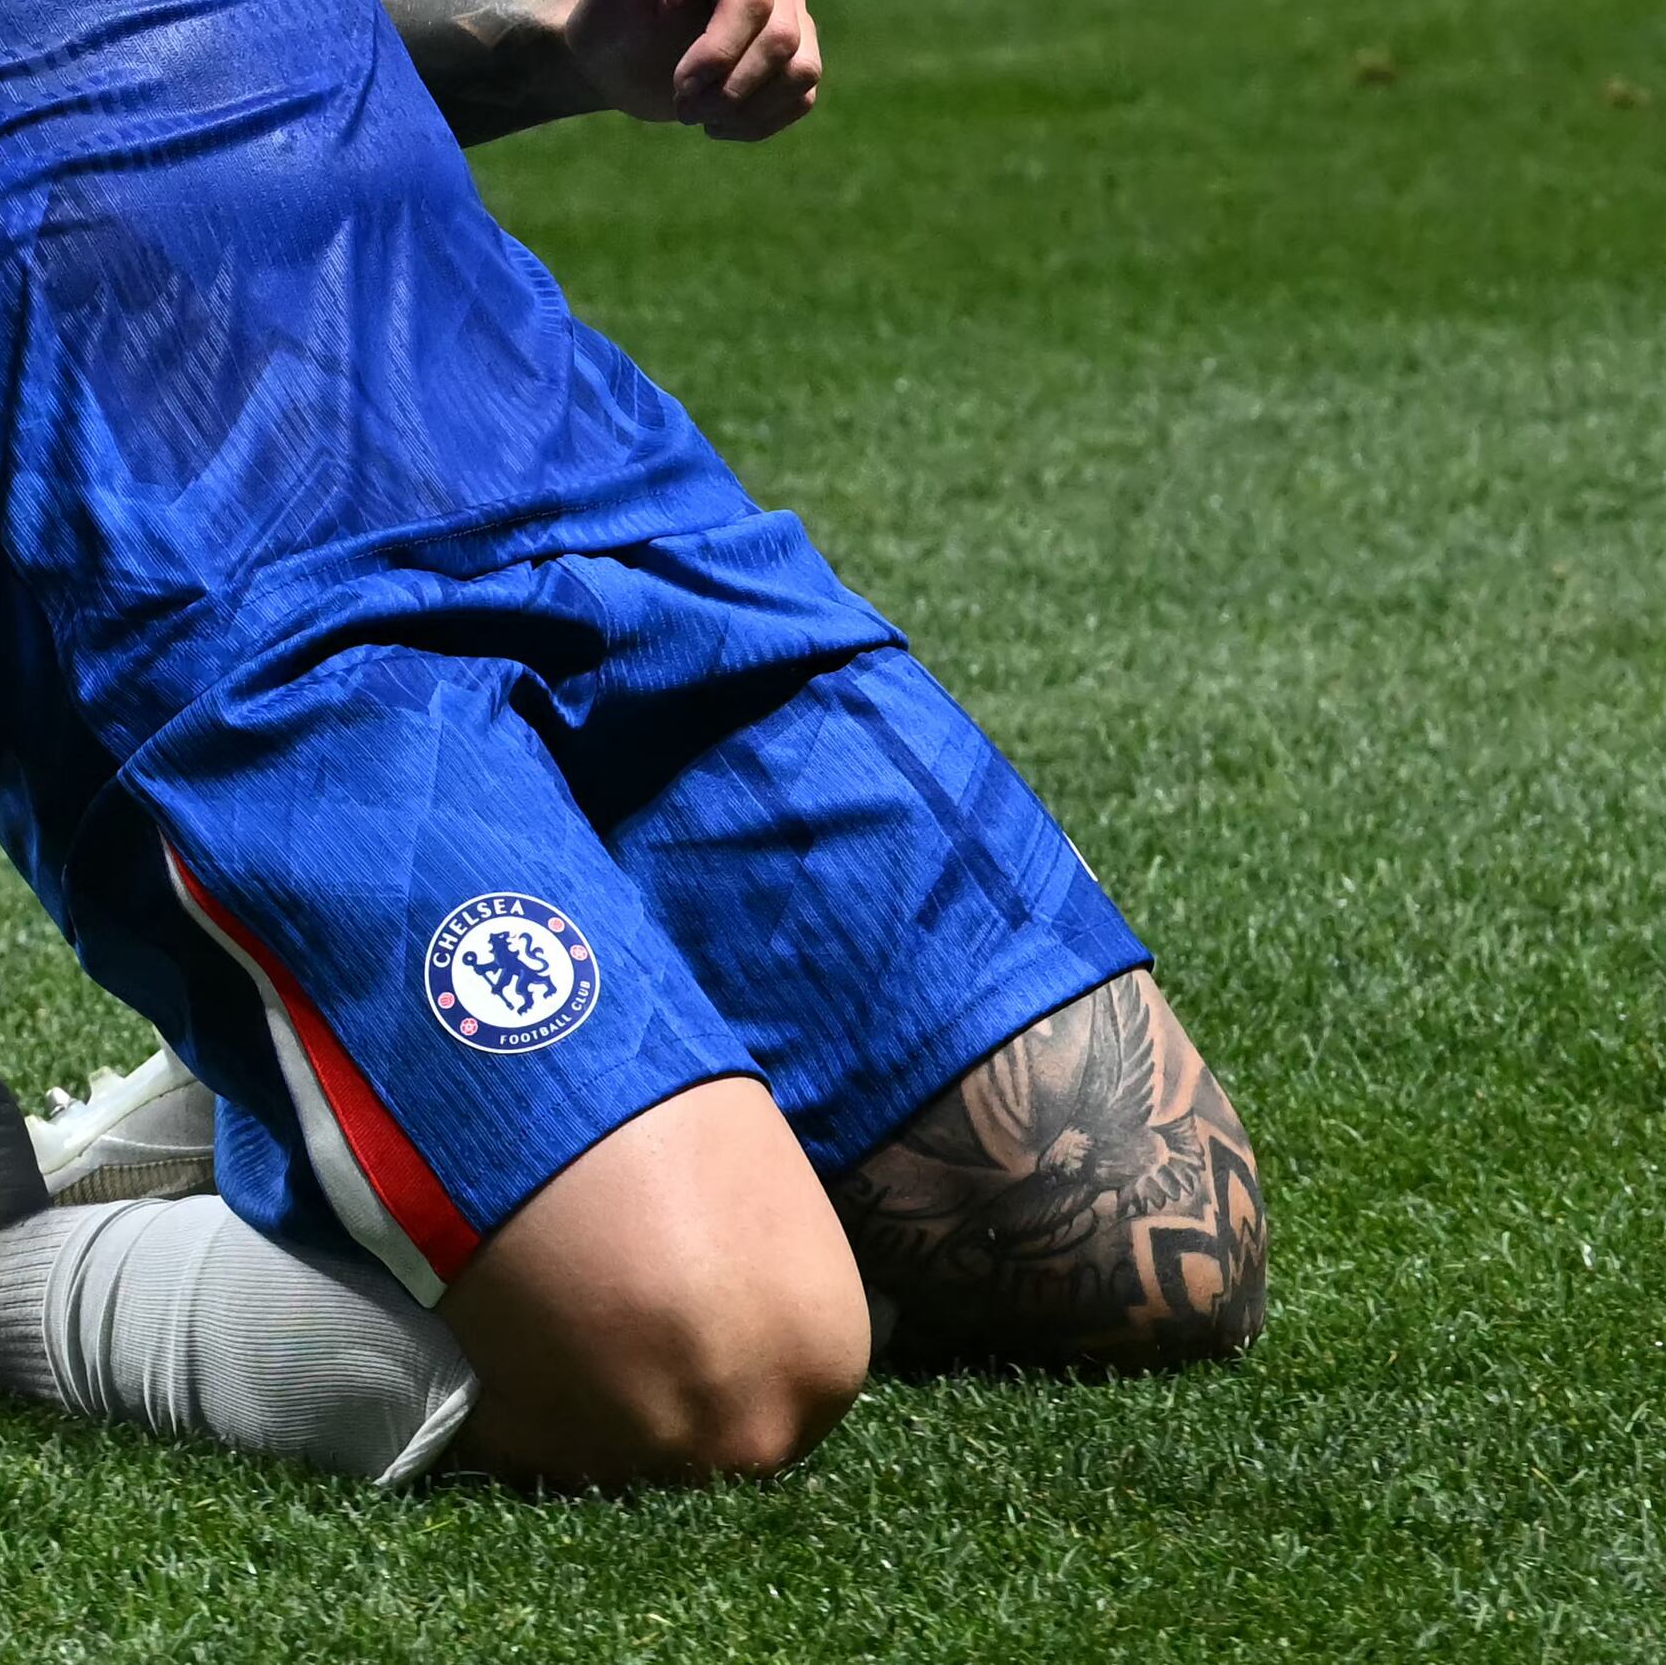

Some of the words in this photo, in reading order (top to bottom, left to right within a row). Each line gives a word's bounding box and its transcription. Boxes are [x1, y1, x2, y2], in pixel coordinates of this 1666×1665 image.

[433, 898, 525, 968] CHELSEA
[499, 1013, 572, 1046] FOOTBALL
[571, 980, 591, 1011] CLUB
